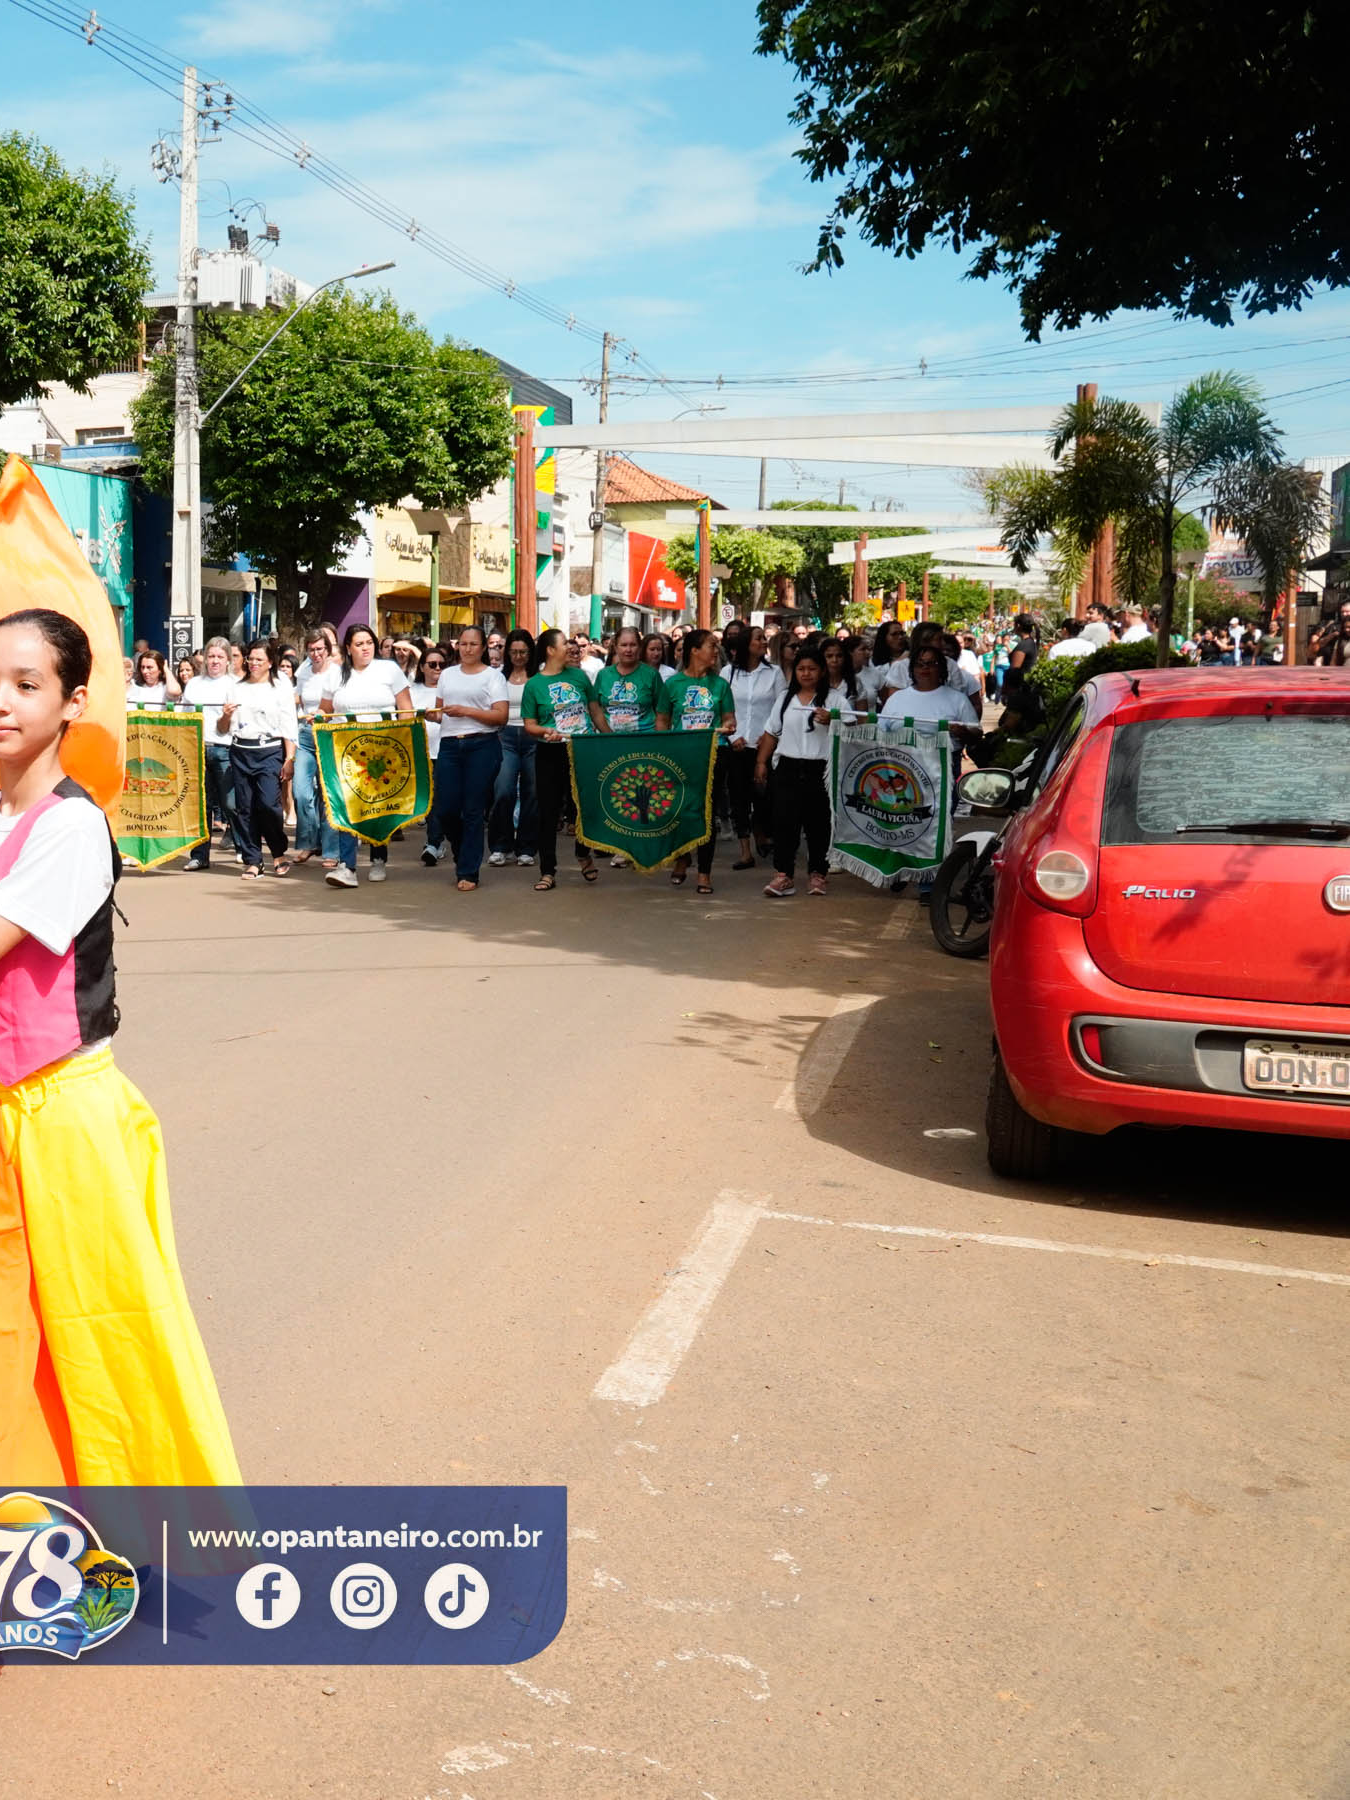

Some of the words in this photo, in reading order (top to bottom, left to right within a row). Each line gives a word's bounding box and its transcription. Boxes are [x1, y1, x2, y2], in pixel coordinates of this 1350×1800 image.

[167, 744, 191, 776] INFANTIL
[391, 744, 409, 768] Infantil
[875, 751, 910, 764] EDUCAÇÃO
[910, 760, 931, 786] INFANTIL
[861, 804, 888, 821] LAURA
[889, 812, 920, 824] VICUÑA
[126, 823, 168, 832] BONITO-MS
[865, 820, 915, 841] BONITO-MS
